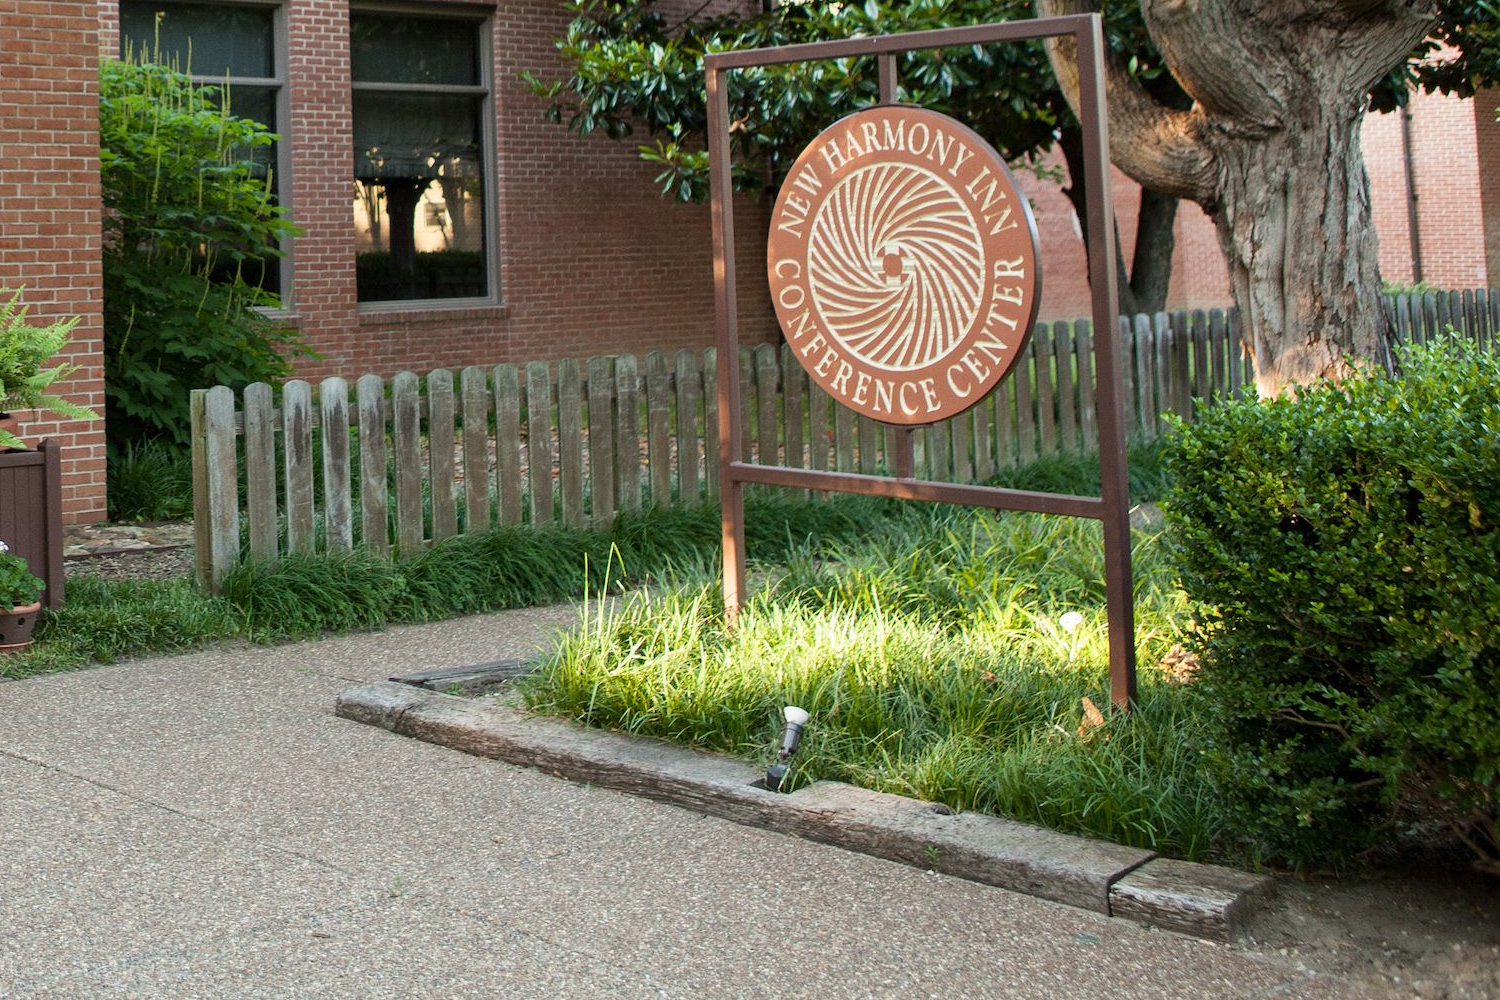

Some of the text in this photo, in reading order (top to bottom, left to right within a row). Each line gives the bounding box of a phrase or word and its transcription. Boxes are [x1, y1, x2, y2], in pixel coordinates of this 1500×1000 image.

[777, 119, 1018, 239] NEW HARMONY INN
[774, 255, 1025, 416] CONFERENCE CENTER
